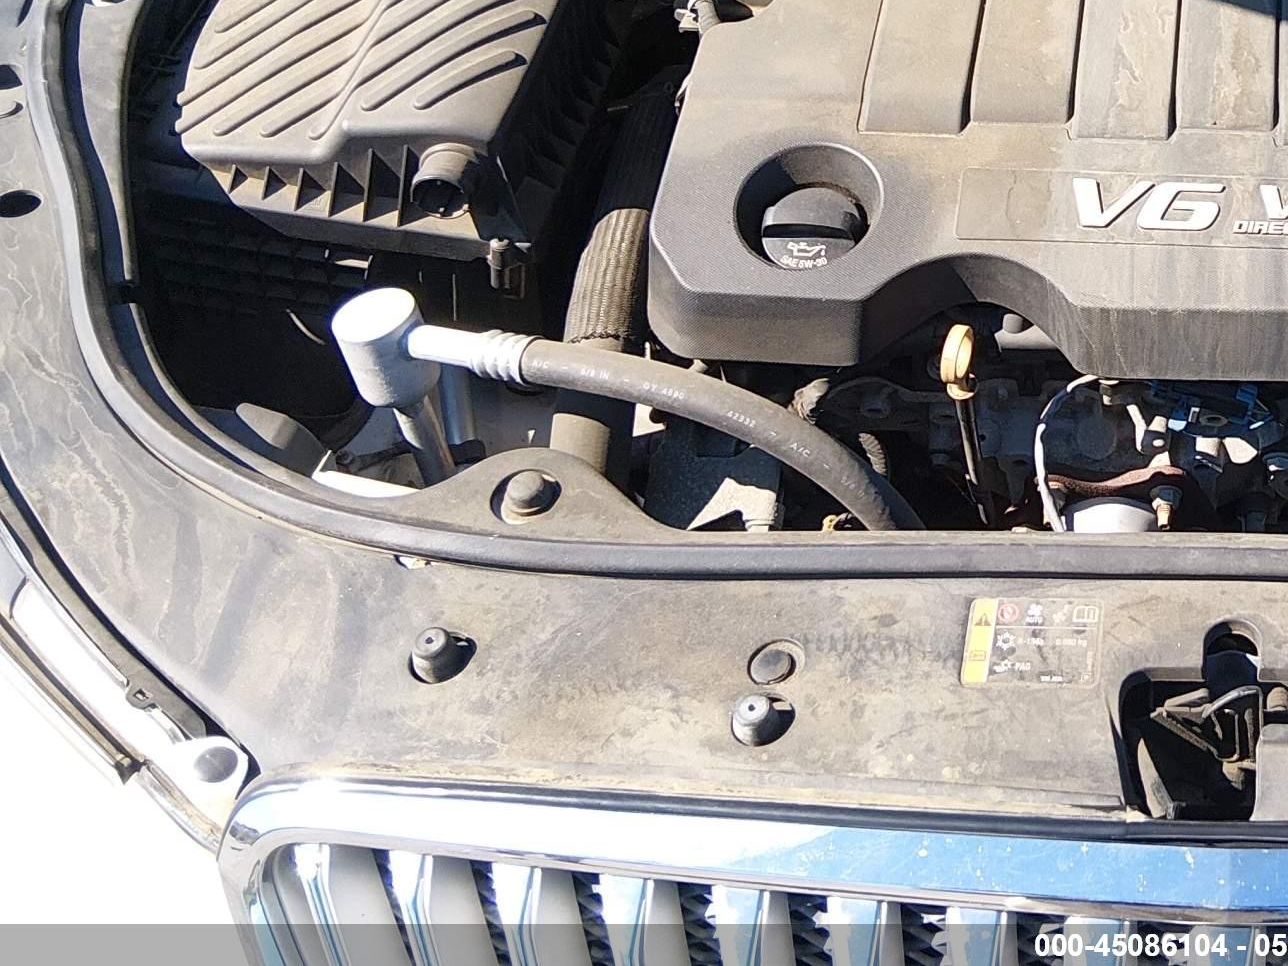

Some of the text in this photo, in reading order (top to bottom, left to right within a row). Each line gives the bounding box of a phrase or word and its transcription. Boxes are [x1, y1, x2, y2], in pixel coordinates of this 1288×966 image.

[1071, 177, 1227, 232] V6
[780, 255, 828, 269] SAE 5W-30
[532, 360, 550, 369] A/C
[789, 442, 811, 458] A/C
[1025, 616, 1043, 624] AUTO
